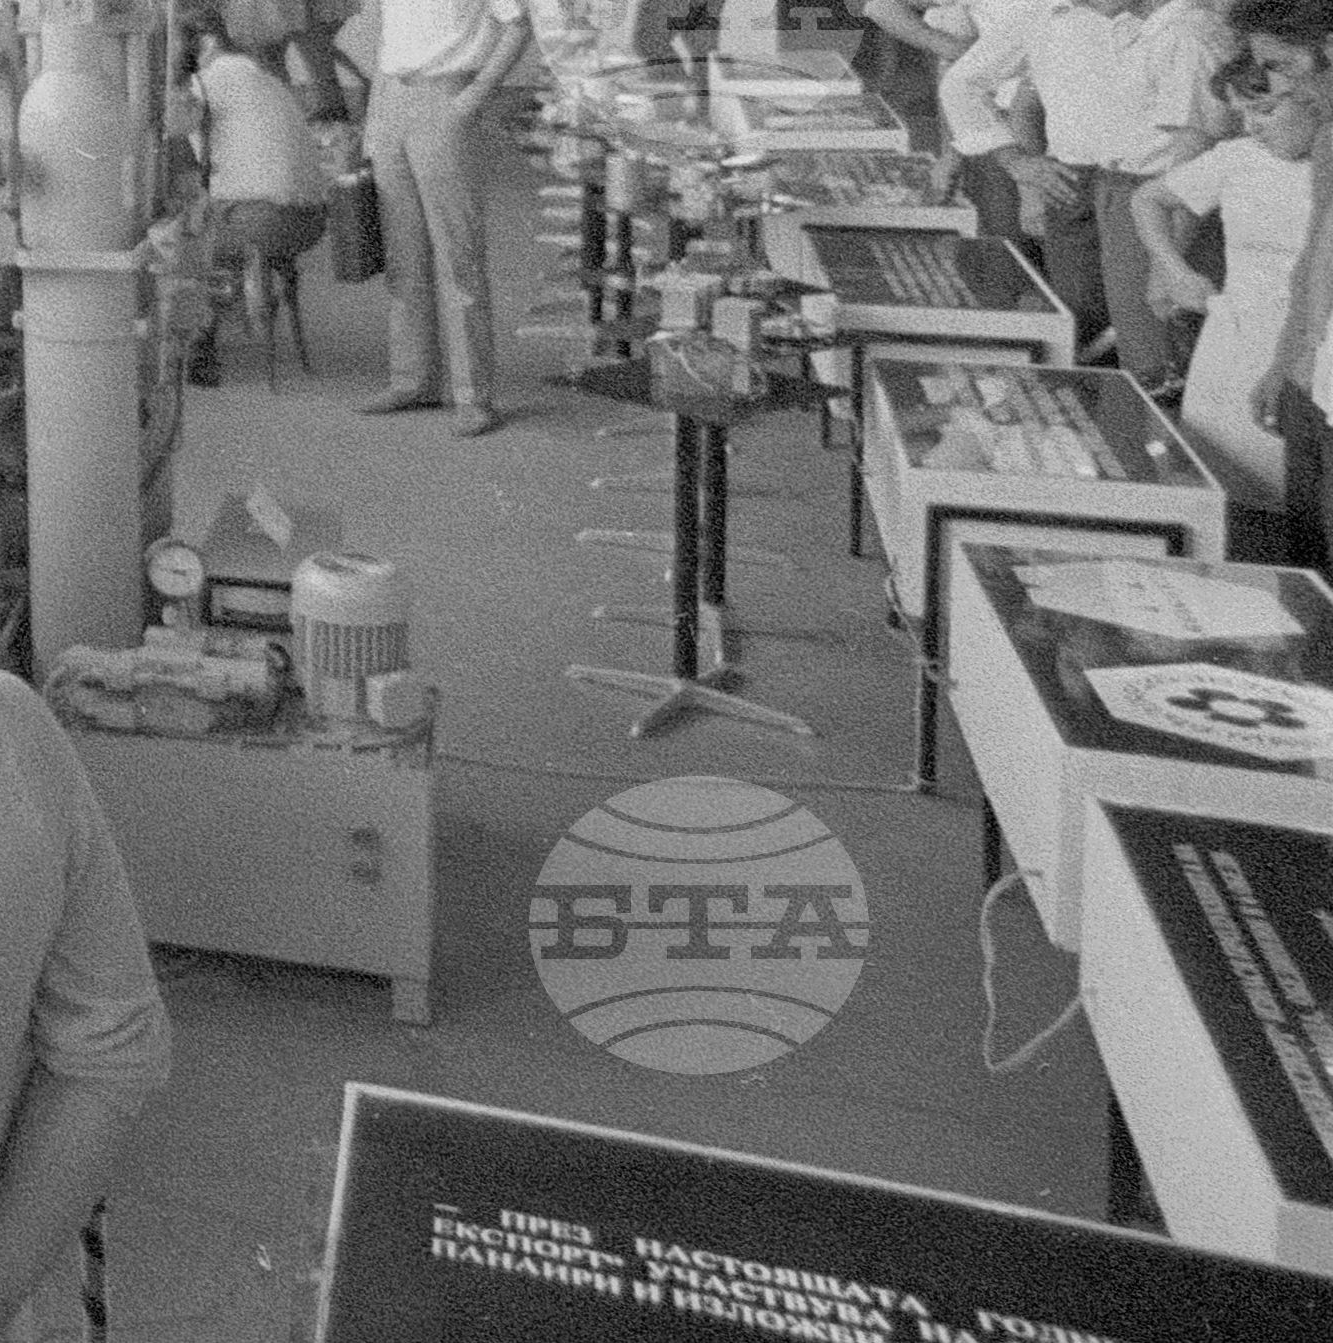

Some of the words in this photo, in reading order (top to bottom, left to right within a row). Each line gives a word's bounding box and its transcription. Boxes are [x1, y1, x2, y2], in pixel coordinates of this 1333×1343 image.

[431, 1237, 622, 1297] ПАНАИРИ
[633, 1280, 662, 1304] И
[673, 1287, 885, 1343] ИЗЛОЖБИ
[499, 1208, 594, 1245] ПРЕЗ
[634, 1237, 931, 1317] НАСТОЯЩАТА
[646, 1260, 892, 1331] УЧАСТВУВА
[918, 1319, 979, 1343] НА
